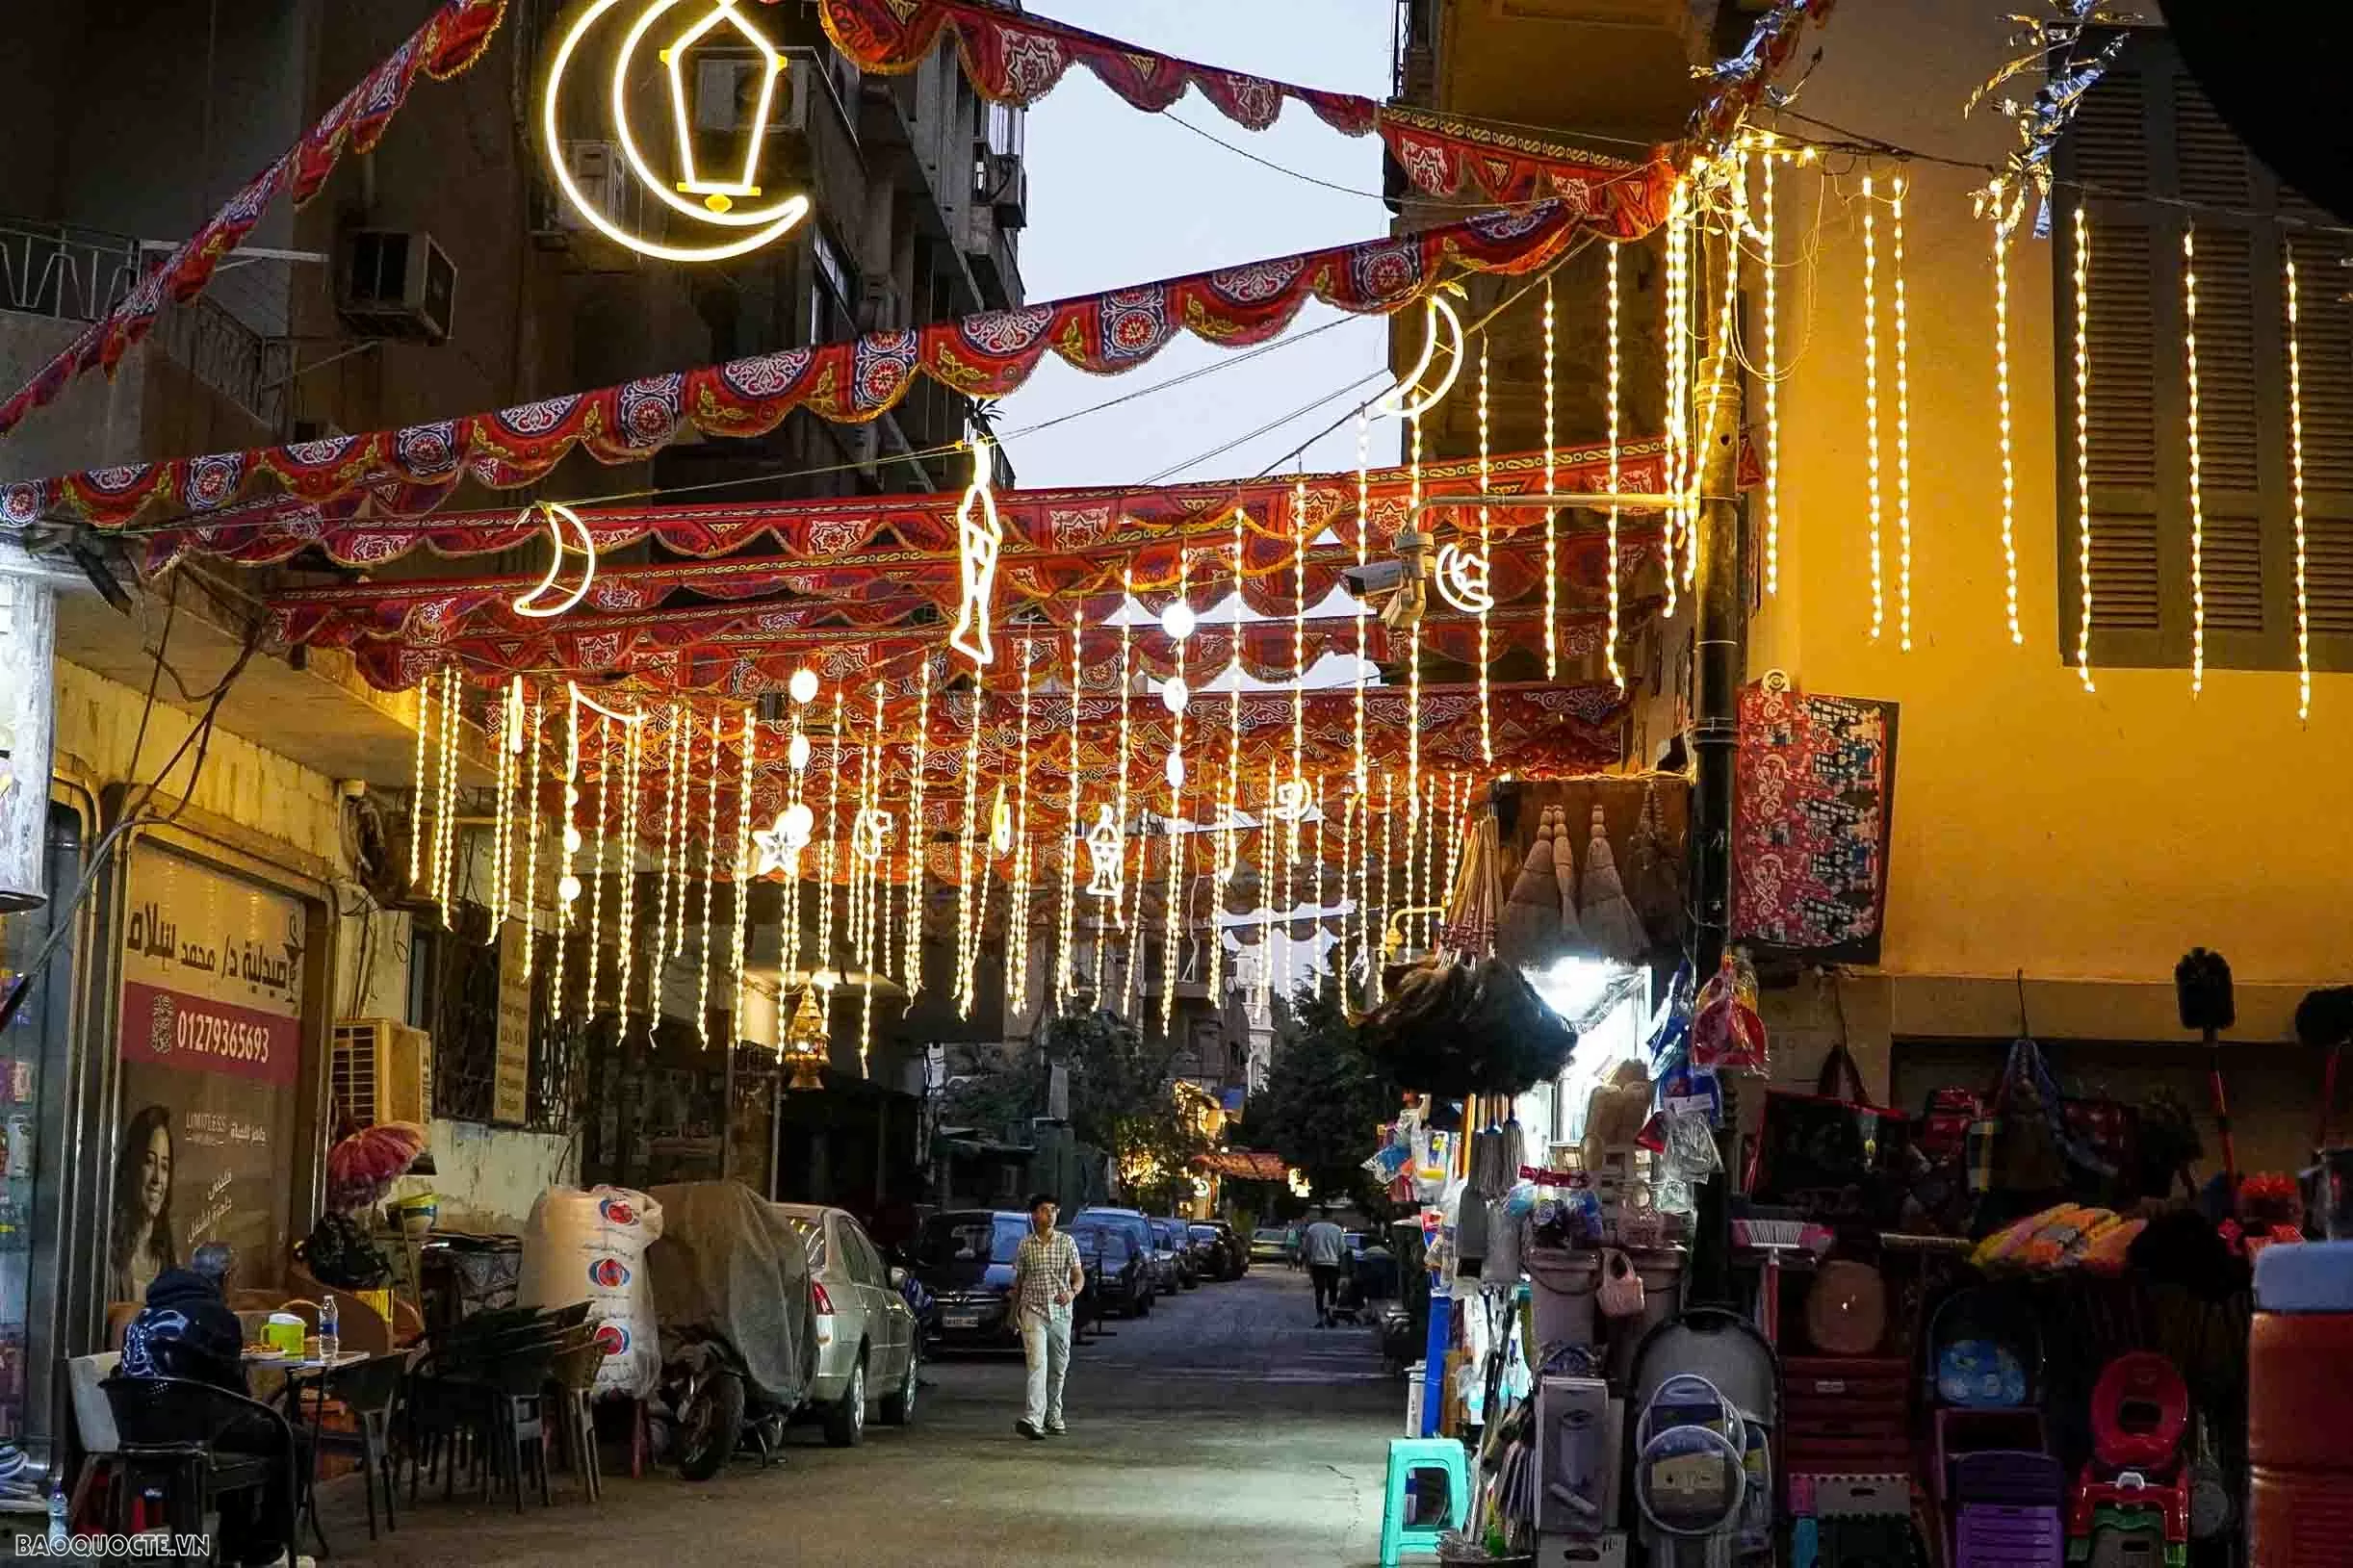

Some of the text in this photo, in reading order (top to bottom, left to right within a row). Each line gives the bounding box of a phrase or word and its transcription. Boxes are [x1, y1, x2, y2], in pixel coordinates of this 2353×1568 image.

[180, 940, 217, 972] محمد
[242, 939, 287, 999] صيدلية
[176, 1010, 271, 1064] 01279365693
